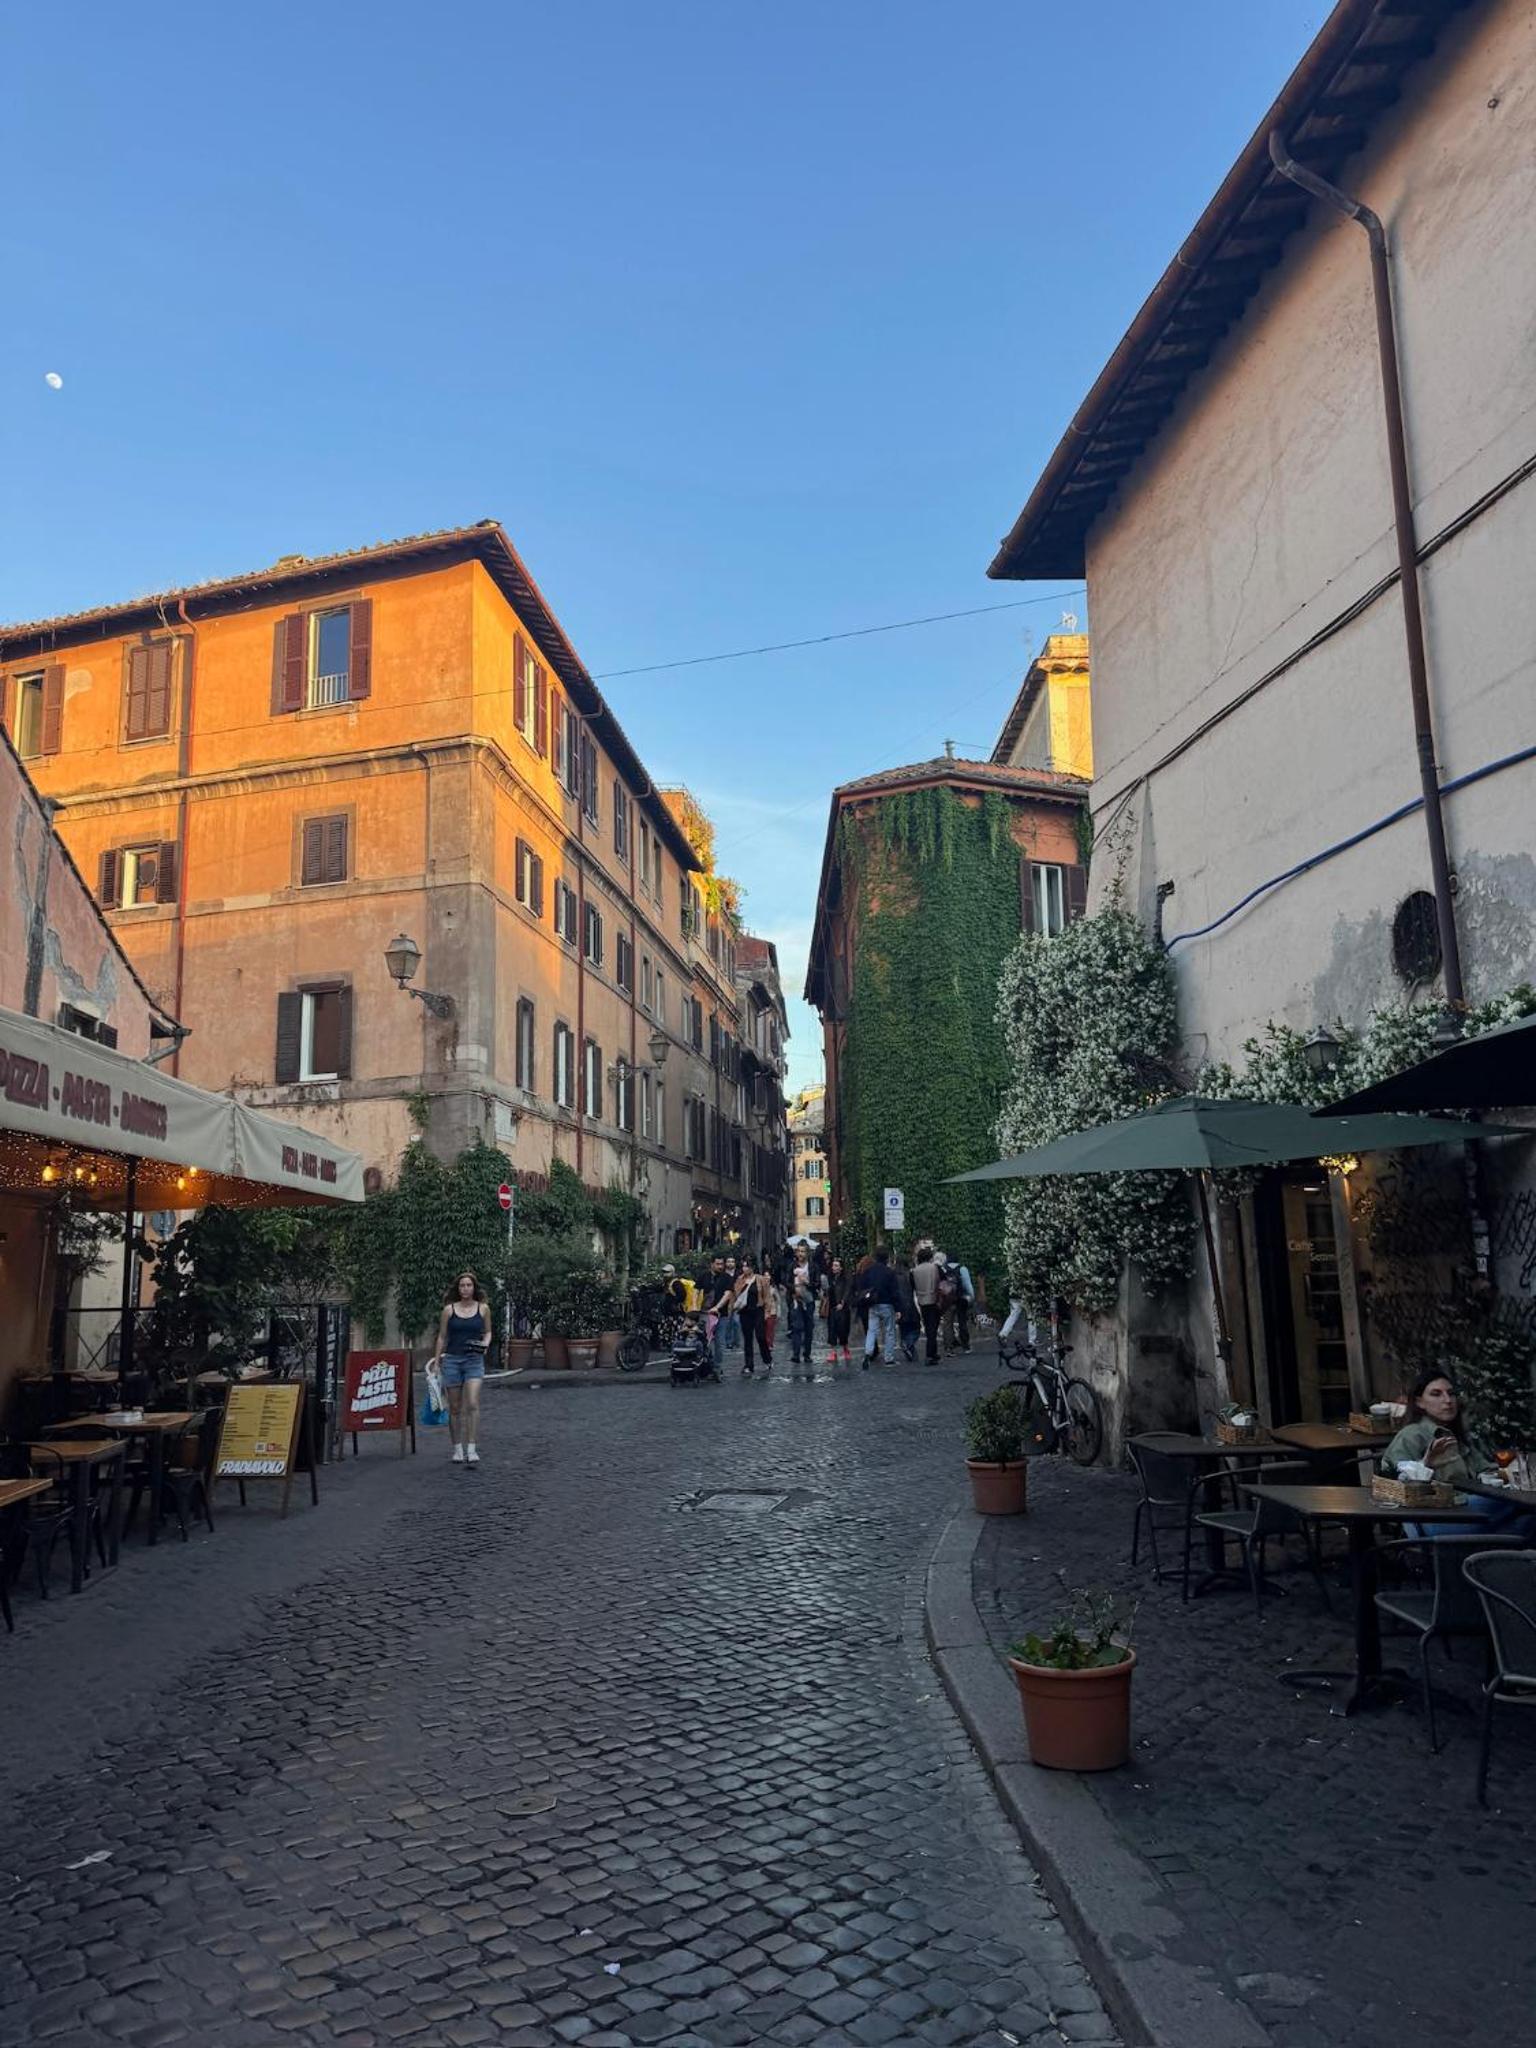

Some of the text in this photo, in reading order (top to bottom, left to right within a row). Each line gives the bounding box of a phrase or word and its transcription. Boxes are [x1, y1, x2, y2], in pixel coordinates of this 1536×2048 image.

[61, 1072, 111, 1127] PASTA
[362, 1365, 395, 1384] PIZZA
[357, 1378, 395, 1398] PASTA
